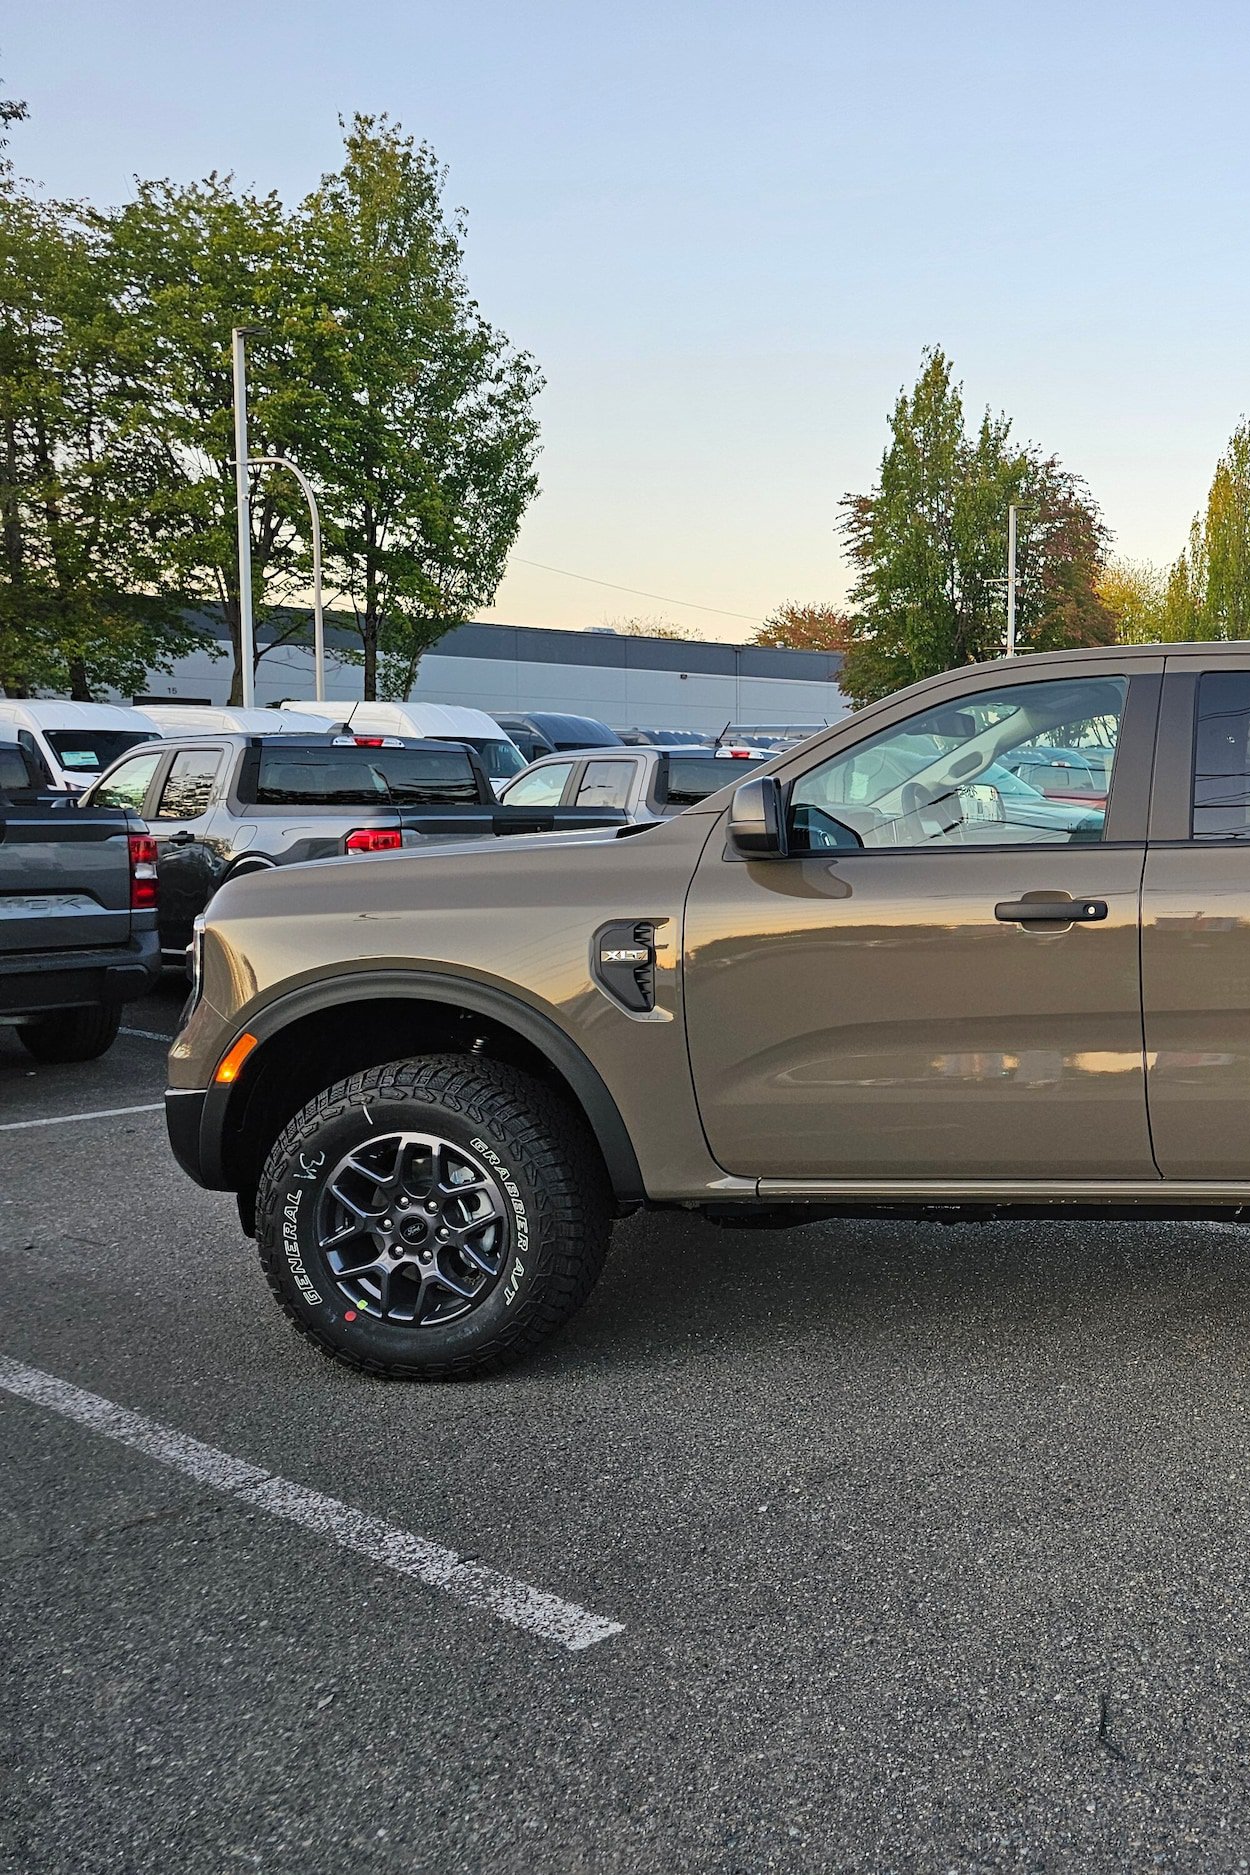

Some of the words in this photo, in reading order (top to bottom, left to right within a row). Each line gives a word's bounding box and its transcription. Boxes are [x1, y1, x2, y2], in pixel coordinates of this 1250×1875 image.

[602, 950, 648, 961] XLT
[281, 1189, 323, 1306] GENERAL
[470, 1137, 529, 1252] GRABBER
